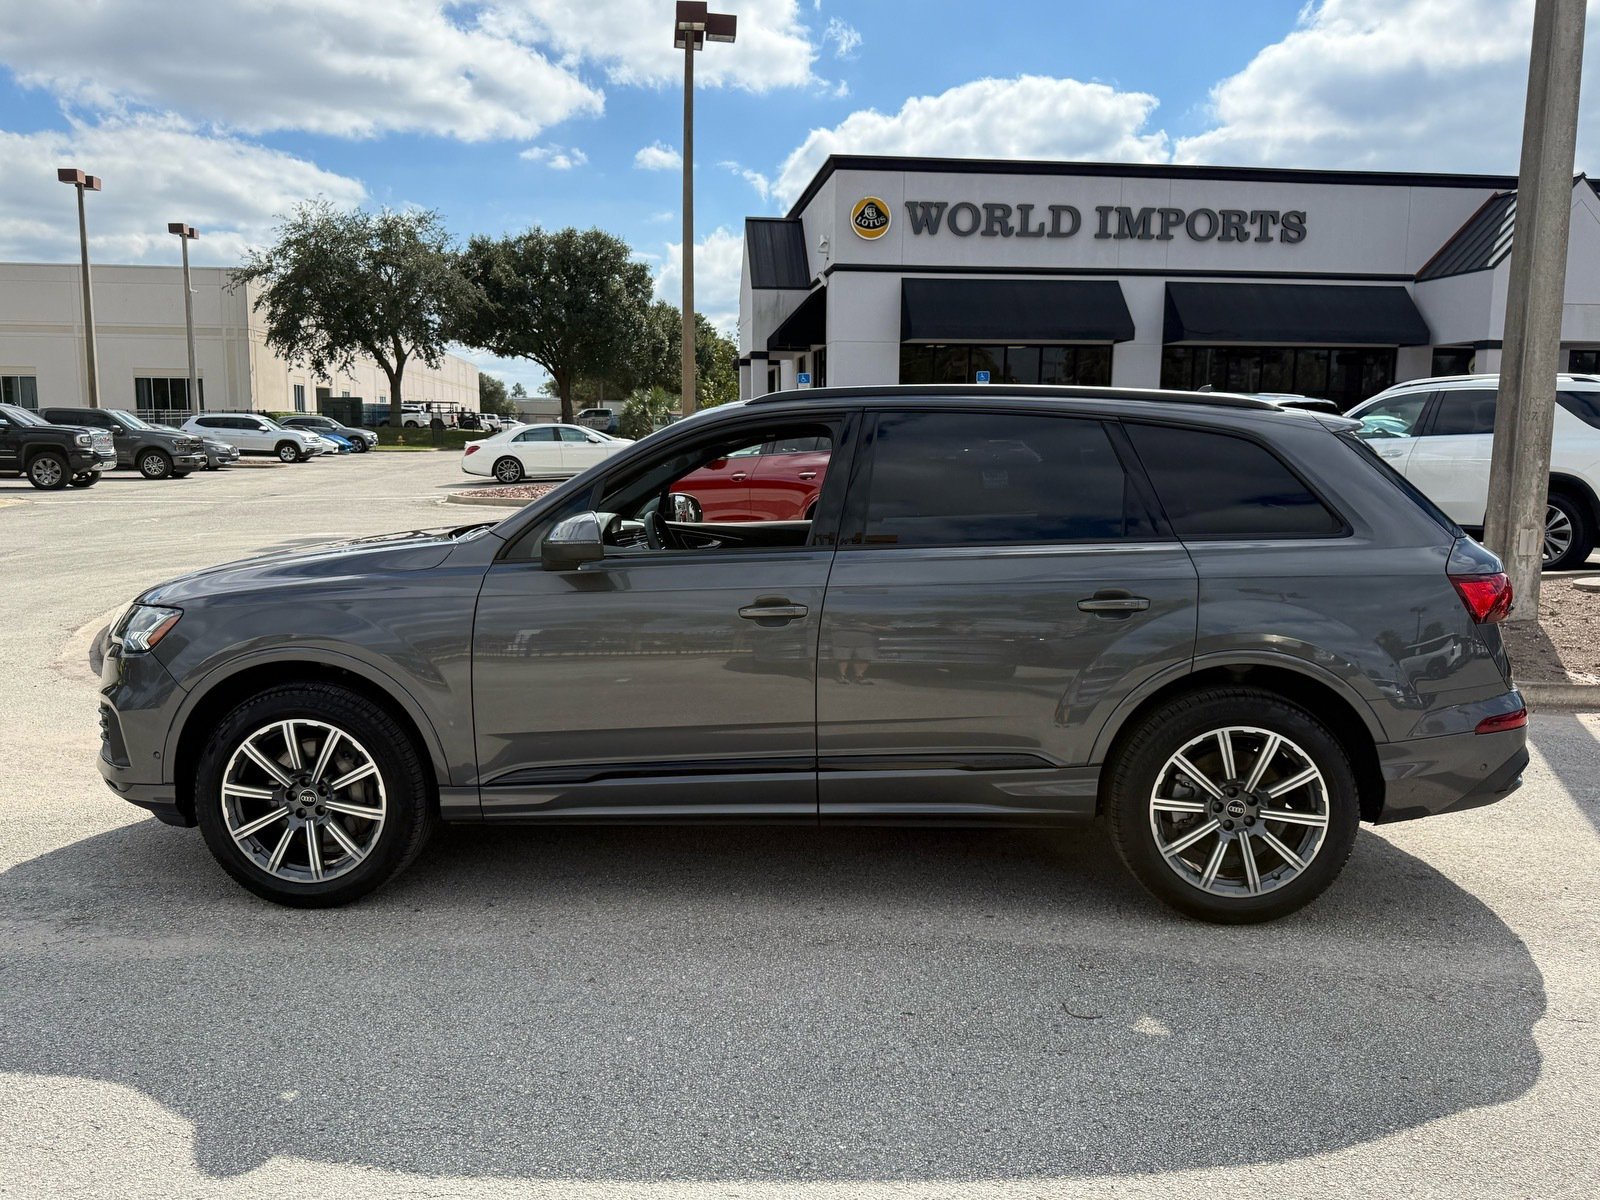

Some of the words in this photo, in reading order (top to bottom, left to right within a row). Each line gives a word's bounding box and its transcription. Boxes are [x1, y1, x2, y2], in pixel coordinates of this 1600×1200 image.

[856, 216, 886, 227] LOTUS
[904, 200, 1081, 239] WORLD
[1094, 205, 1308, 244] IMPORTS
